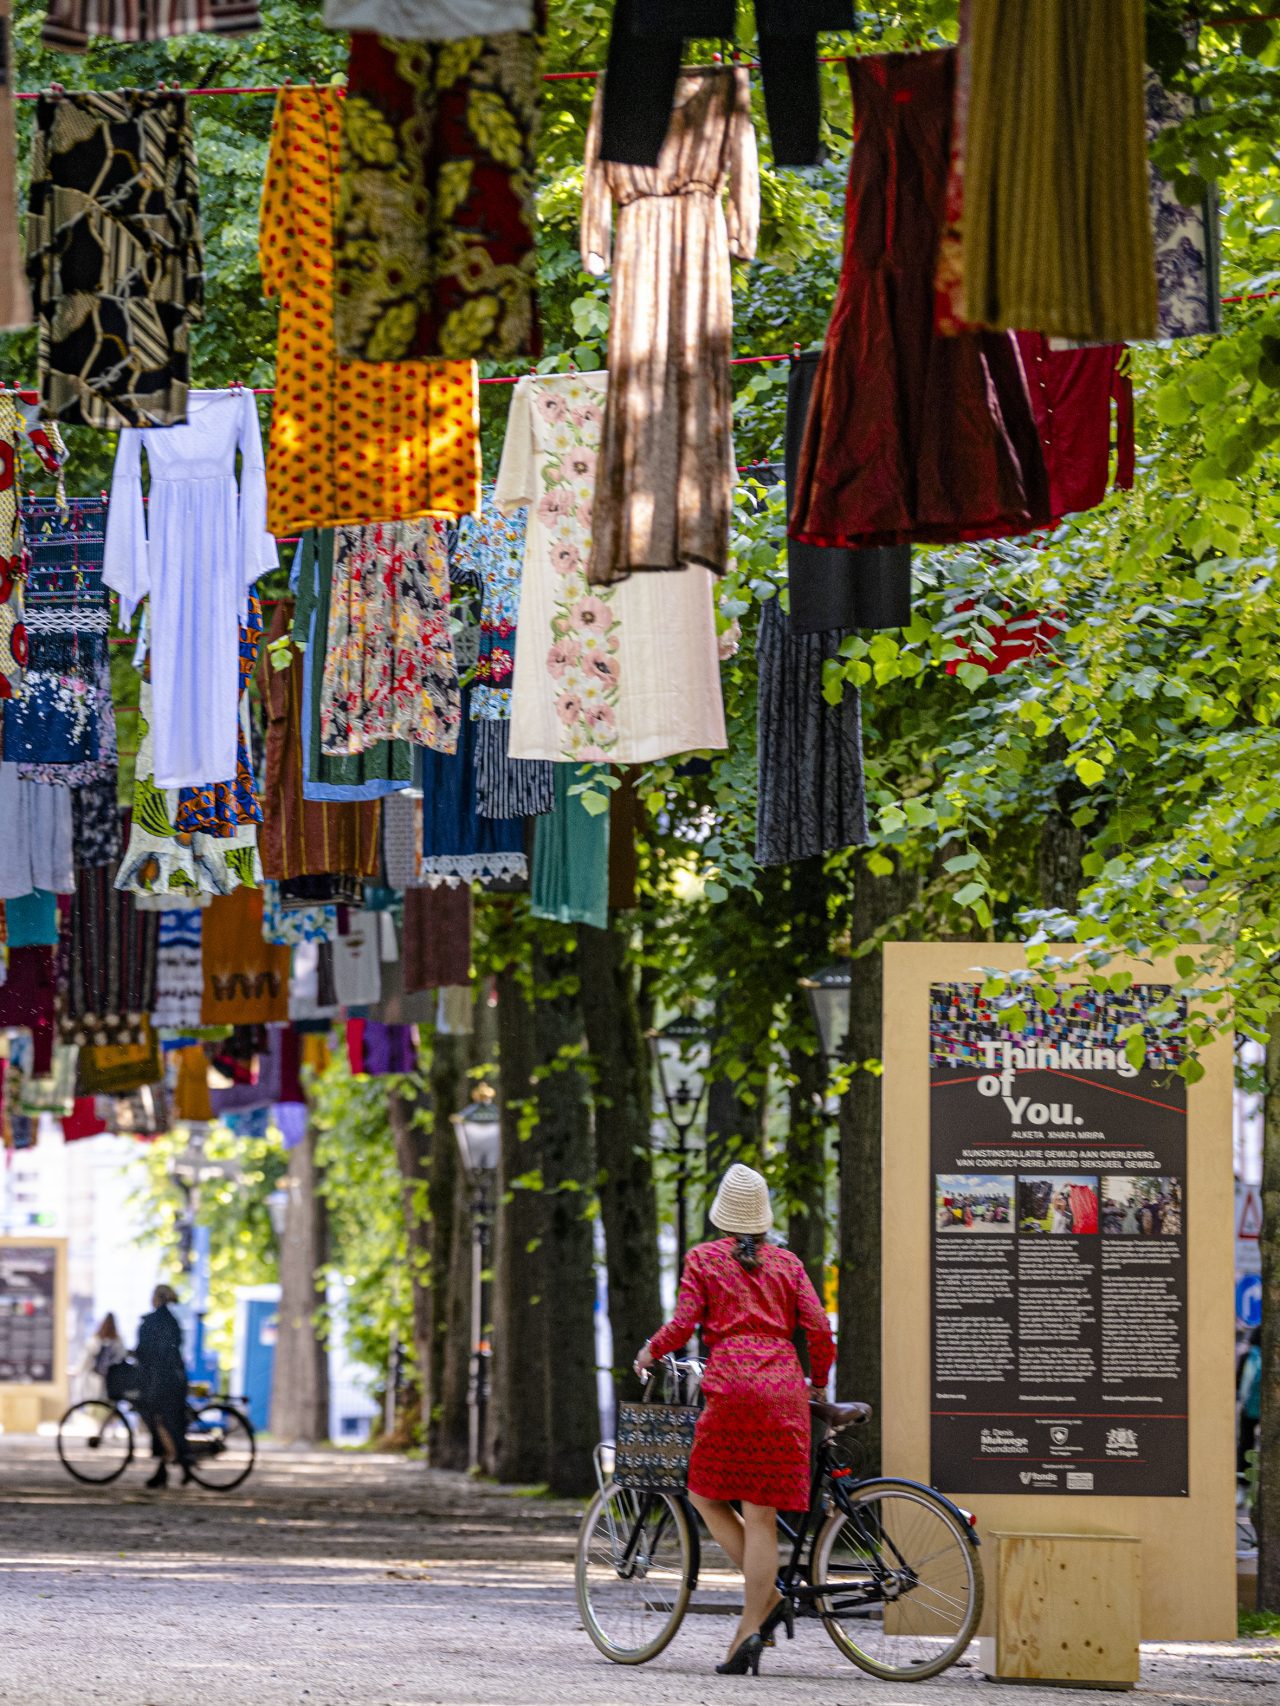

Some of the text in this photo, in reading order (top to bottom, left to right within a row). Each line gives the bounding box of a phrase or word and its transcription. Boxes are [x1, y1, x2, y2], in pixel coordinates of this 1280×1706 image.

[976, 1040, 1140, 1078] Thinking
[976, 1067, 1017, 1097] of
[1002, 1096, 1084, 1125] You.
[1011, 1130, 1045, 1139] ALKETA
[962, 1149, 1156, 1160] KUNSTINSTALLATIE GEWIJD AAN OVERLEVERS
[955, 1158, 975, 1167] VAN
[1080, 1160, 1124, 1169] SEKSUEEL
[1124, 1160, 1162, 1169] GEWELD
[981, 1435, 1029, 1447] Mukwege
[981, 1444, 1029, 1454] Foundation
